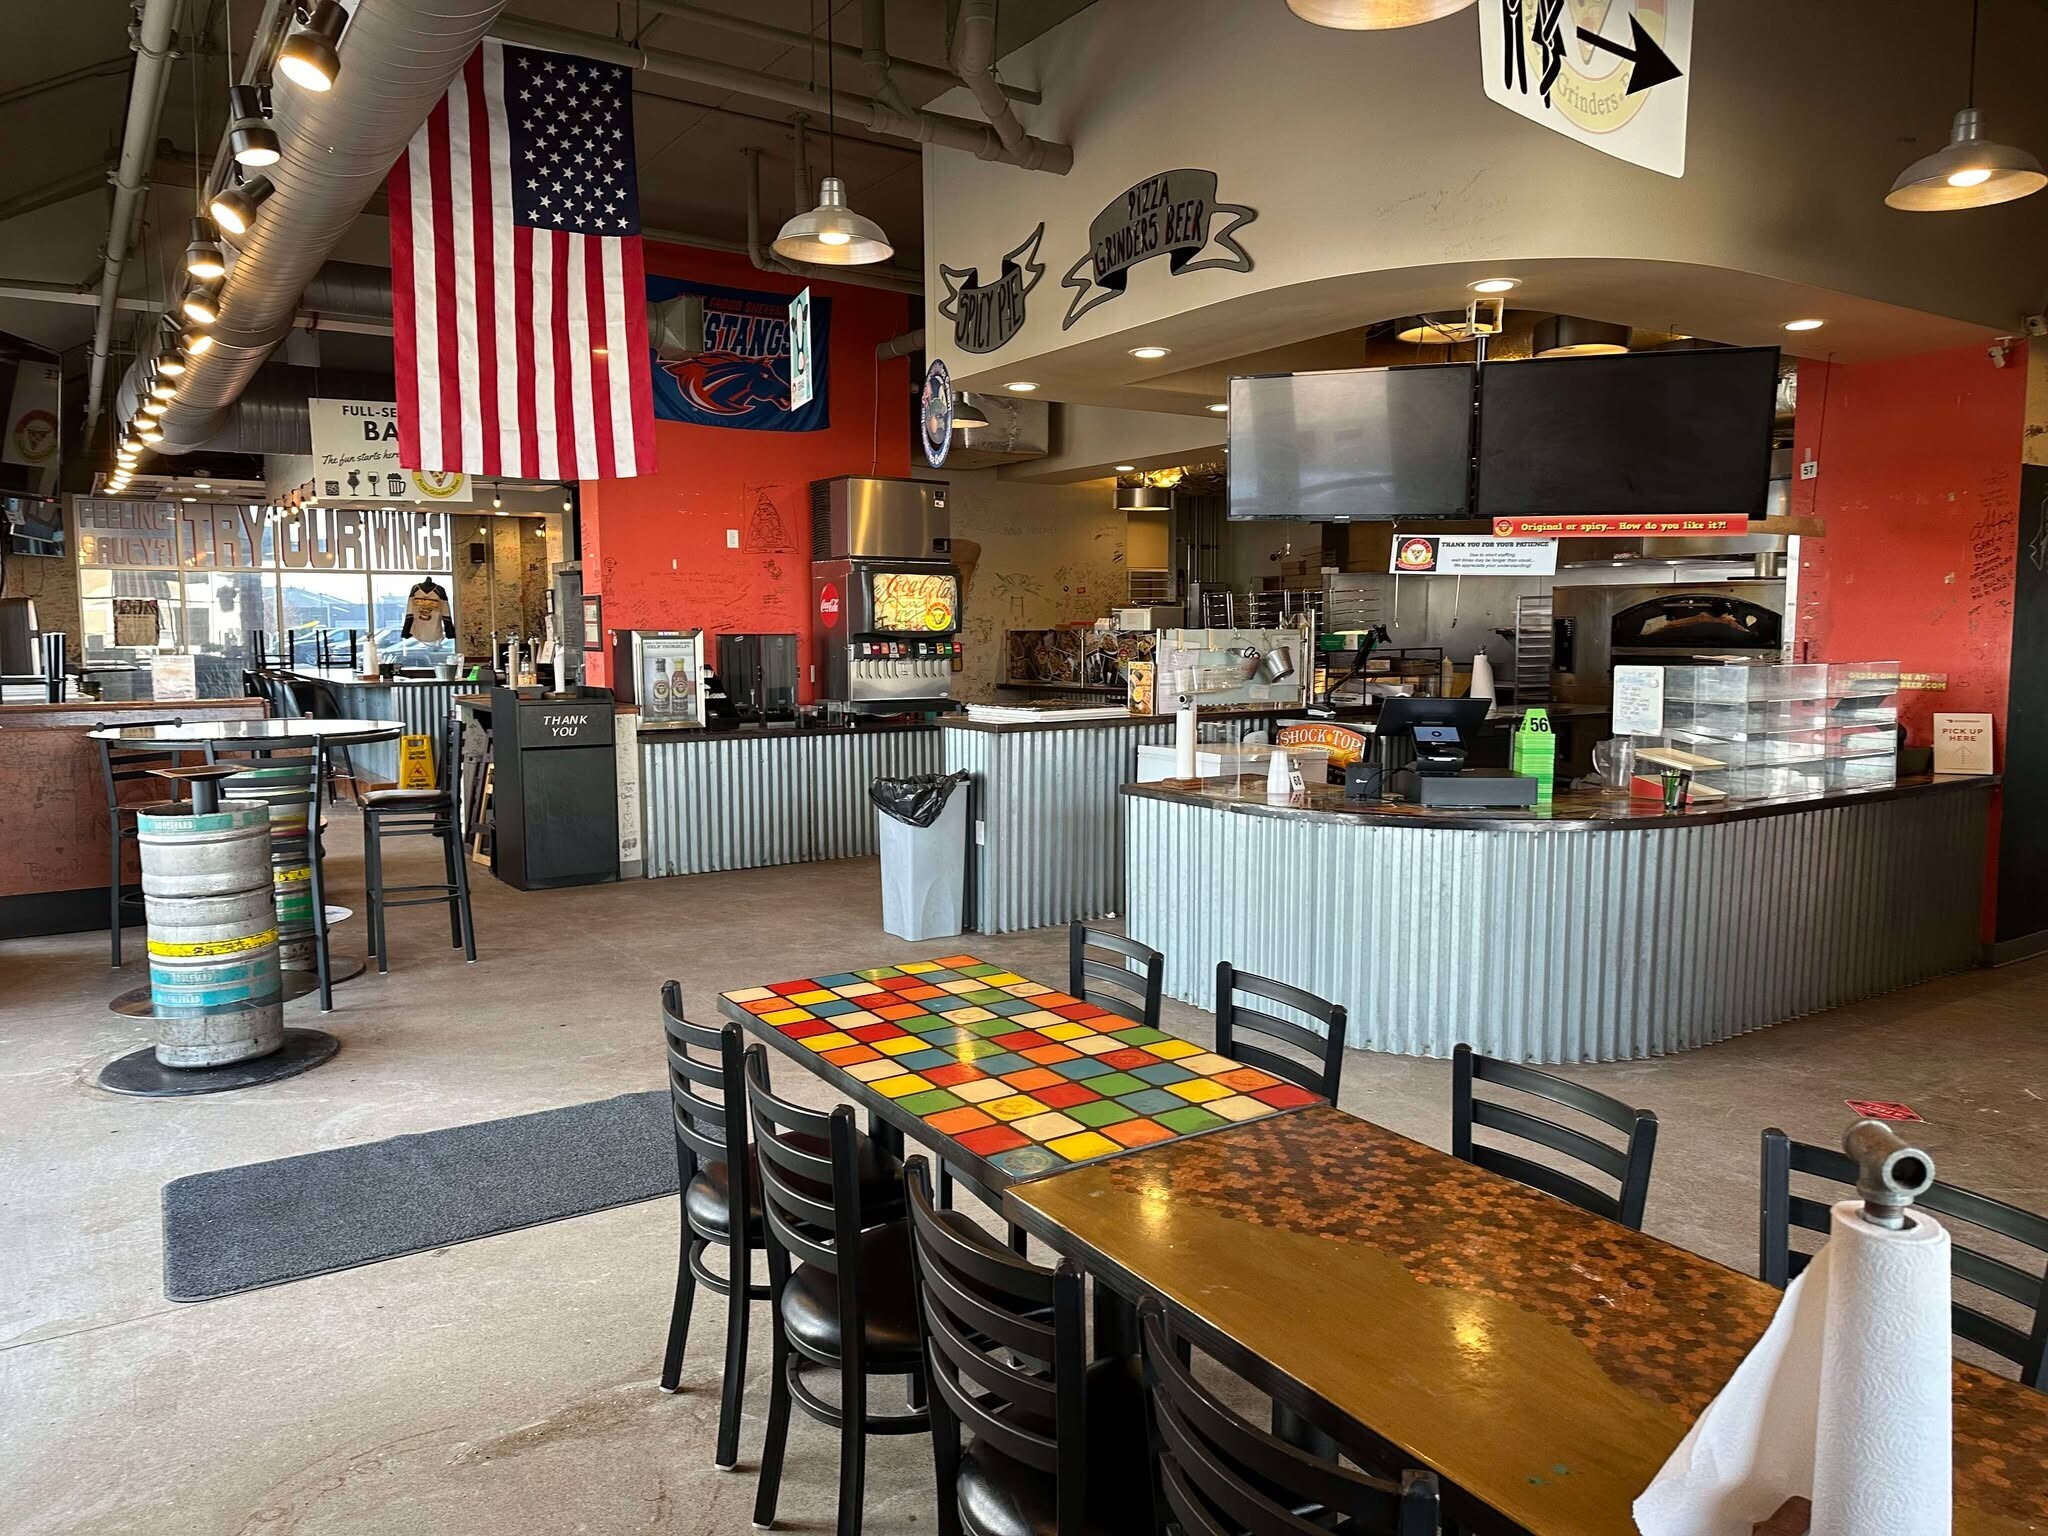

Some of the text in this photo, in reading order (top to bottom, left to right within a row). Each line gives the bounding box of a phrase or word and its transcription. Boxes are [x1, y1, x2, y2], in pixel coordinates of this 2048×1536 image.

[1556, 72, 1620, 116] Grinders
[1128, 176, 1170, 220] PIZZA
[1095, 200, 1203, 275] GRINDERS BEER
[956, 273, 1022, 348] SPICY PIE
[704, 310, 791, 358] STANGS
[342, 405, 397, 418] FULL-SE
[364, 420, 399, 442] BA
[322, 454, 338, 465] The
[339, 453, 356, 466] fun
[356, 451, 382, 462] starts
[1803, 464, 1815, 475] 57
[79, 501, 451, 571] FEELING TRY OUR WINGS!
[1521, 523, 1562, 533] Original
[1580, 523, 1615, 533] spicy...
[1619, 522, 1642, 530] How
[1644, 522, 1657, 530] do
[1661, 524, 1679, 532] you
[1683, 521, 1704, 529] like
[1708, 521, 1727, 529] it?!
[543, 715, 588, 726] THANK
[551, 726, 578, 737] YOU
[1530, 717, 1548, 732] 56
[1280, 728, 1362, 752] SHOCK TOP
